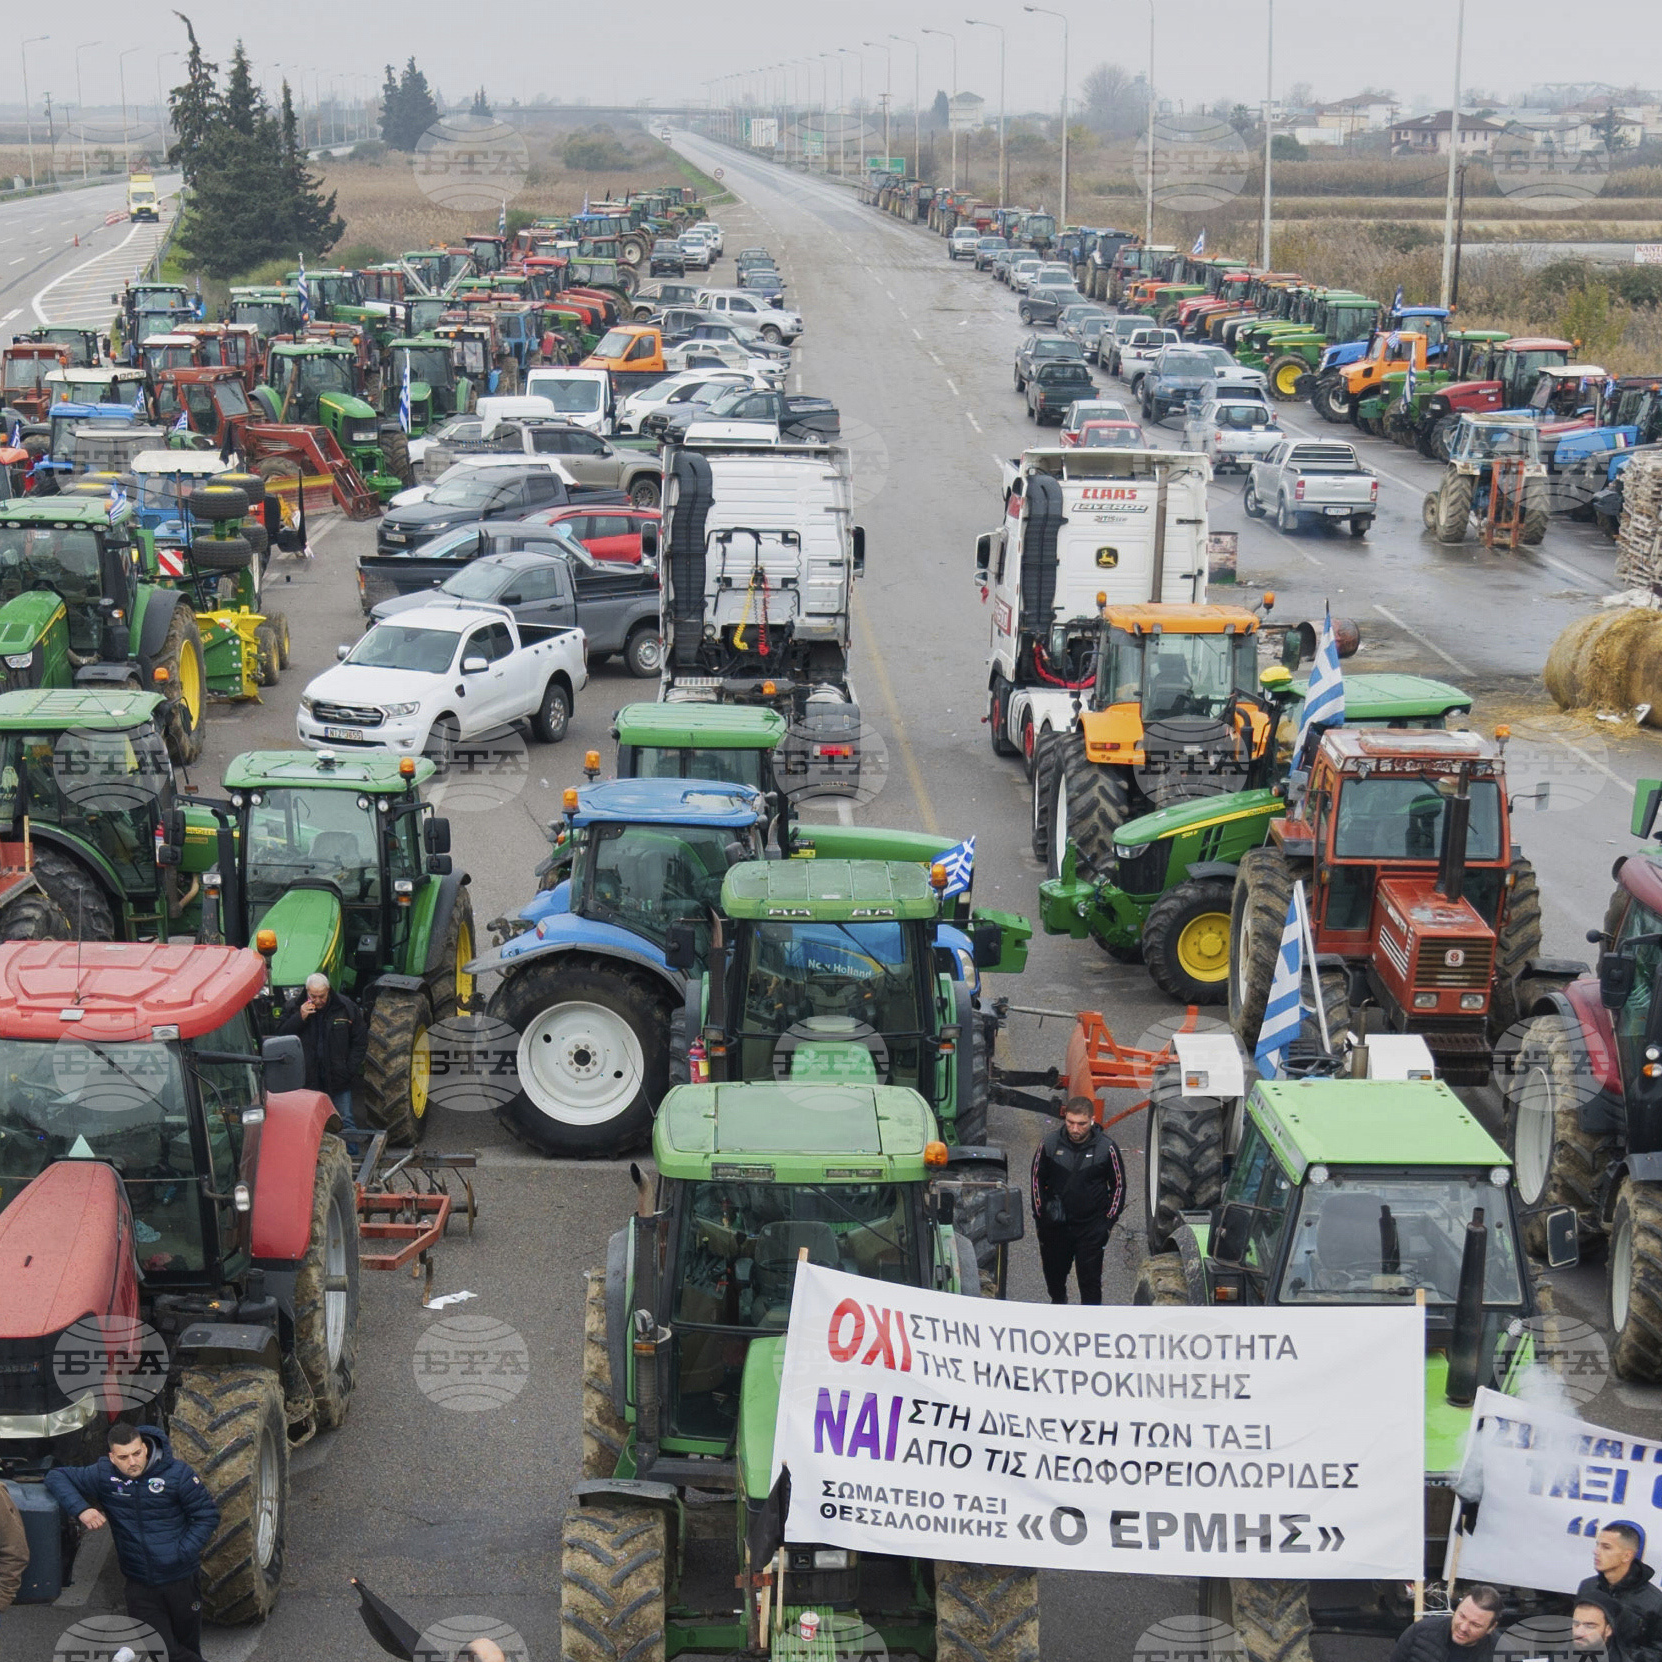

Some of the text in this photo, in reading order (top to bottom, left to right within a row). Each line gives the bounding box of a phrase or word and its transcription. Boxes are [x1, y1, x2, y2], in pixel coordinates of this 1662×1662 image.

[1082, 488, 1138, 500] CLAAS
[807, 959, 872, 979] New Holland
[827, 1297, 1299, 1373] ΟΧΙ ΣΤΗΝ ΥΠΟΧΡΕΩΤΙΚΟΤΗΤΑ
[916, 1350, 1252, 1400] ΤΗΣ ΗΛΕΚΤΡΟΚΙΝΗΣΗΣ
[813, 1386, 1272, 1462] ΝΑΙ ΣΤΗ ΔΙΕΛΕΥΣΗ ΤΩΝ ΤΑΞΙ
[901, 1438, 1360, 1490] ΑΠΟ ΤΙΣ ΛΕΩΦΟΡΕΙΟΛΩΡΙΔΕΣ
[1526, 1457, 1629, 1506] ΤΑΞΙ
[821, 1479, 1008, 1516] ΣΩΜΑΤΕΙΟ ΤΑΞΙ
[819, 1501, 1346, 1553] ΘΕΣΣΑΛΟΝΙΚΗΣ «Ο ΕΡΜΗΣ»
